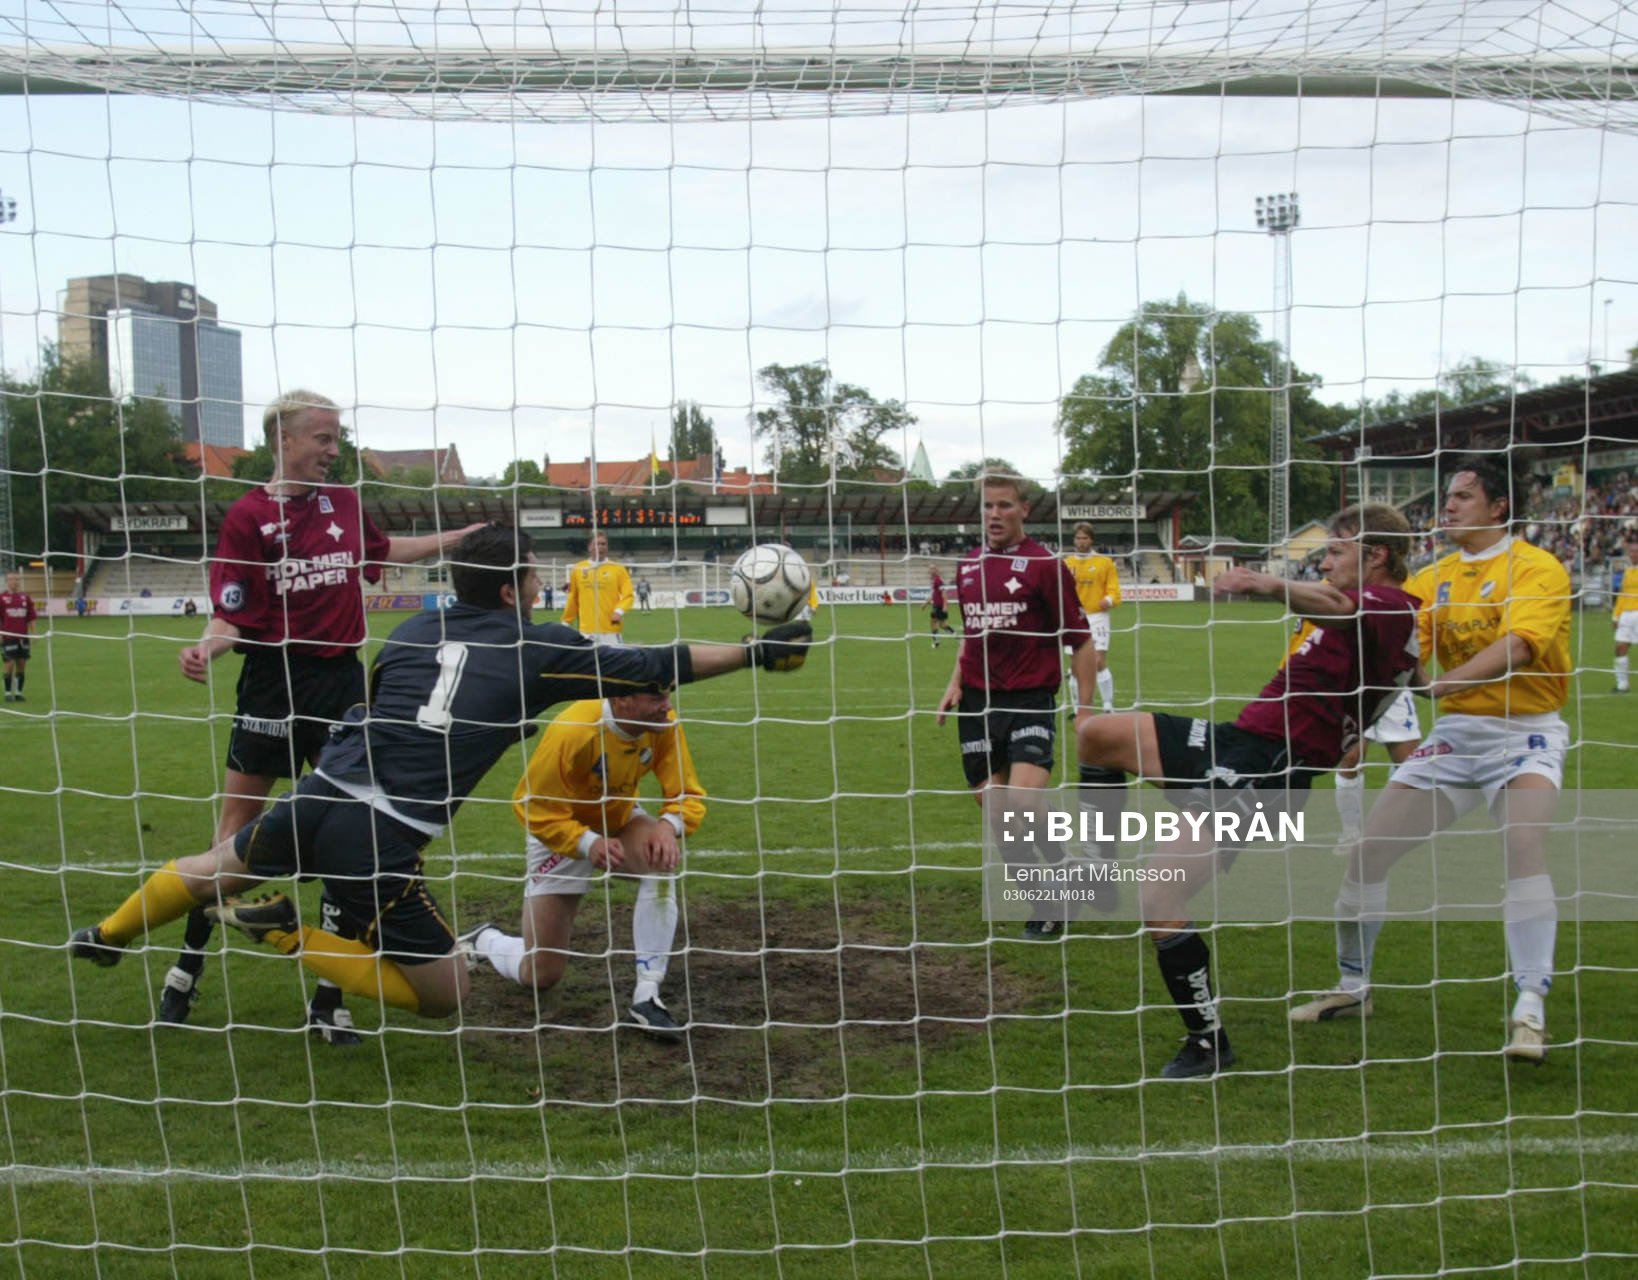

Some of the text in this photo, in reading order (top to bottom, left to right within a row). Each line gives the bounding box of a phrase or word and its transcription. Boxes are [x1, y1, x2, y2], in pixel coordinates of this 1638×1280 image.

[1066, 506, 1142, 519] WIHLBORGS
[116, 516, 186, 531] SYDKRAFT
[265, 551, 355, 581] HOLMEN
[275, 569, 348, 596] PAPER
[223, 590, 241, 604] 13
[416, 642, 469, 734] 1
